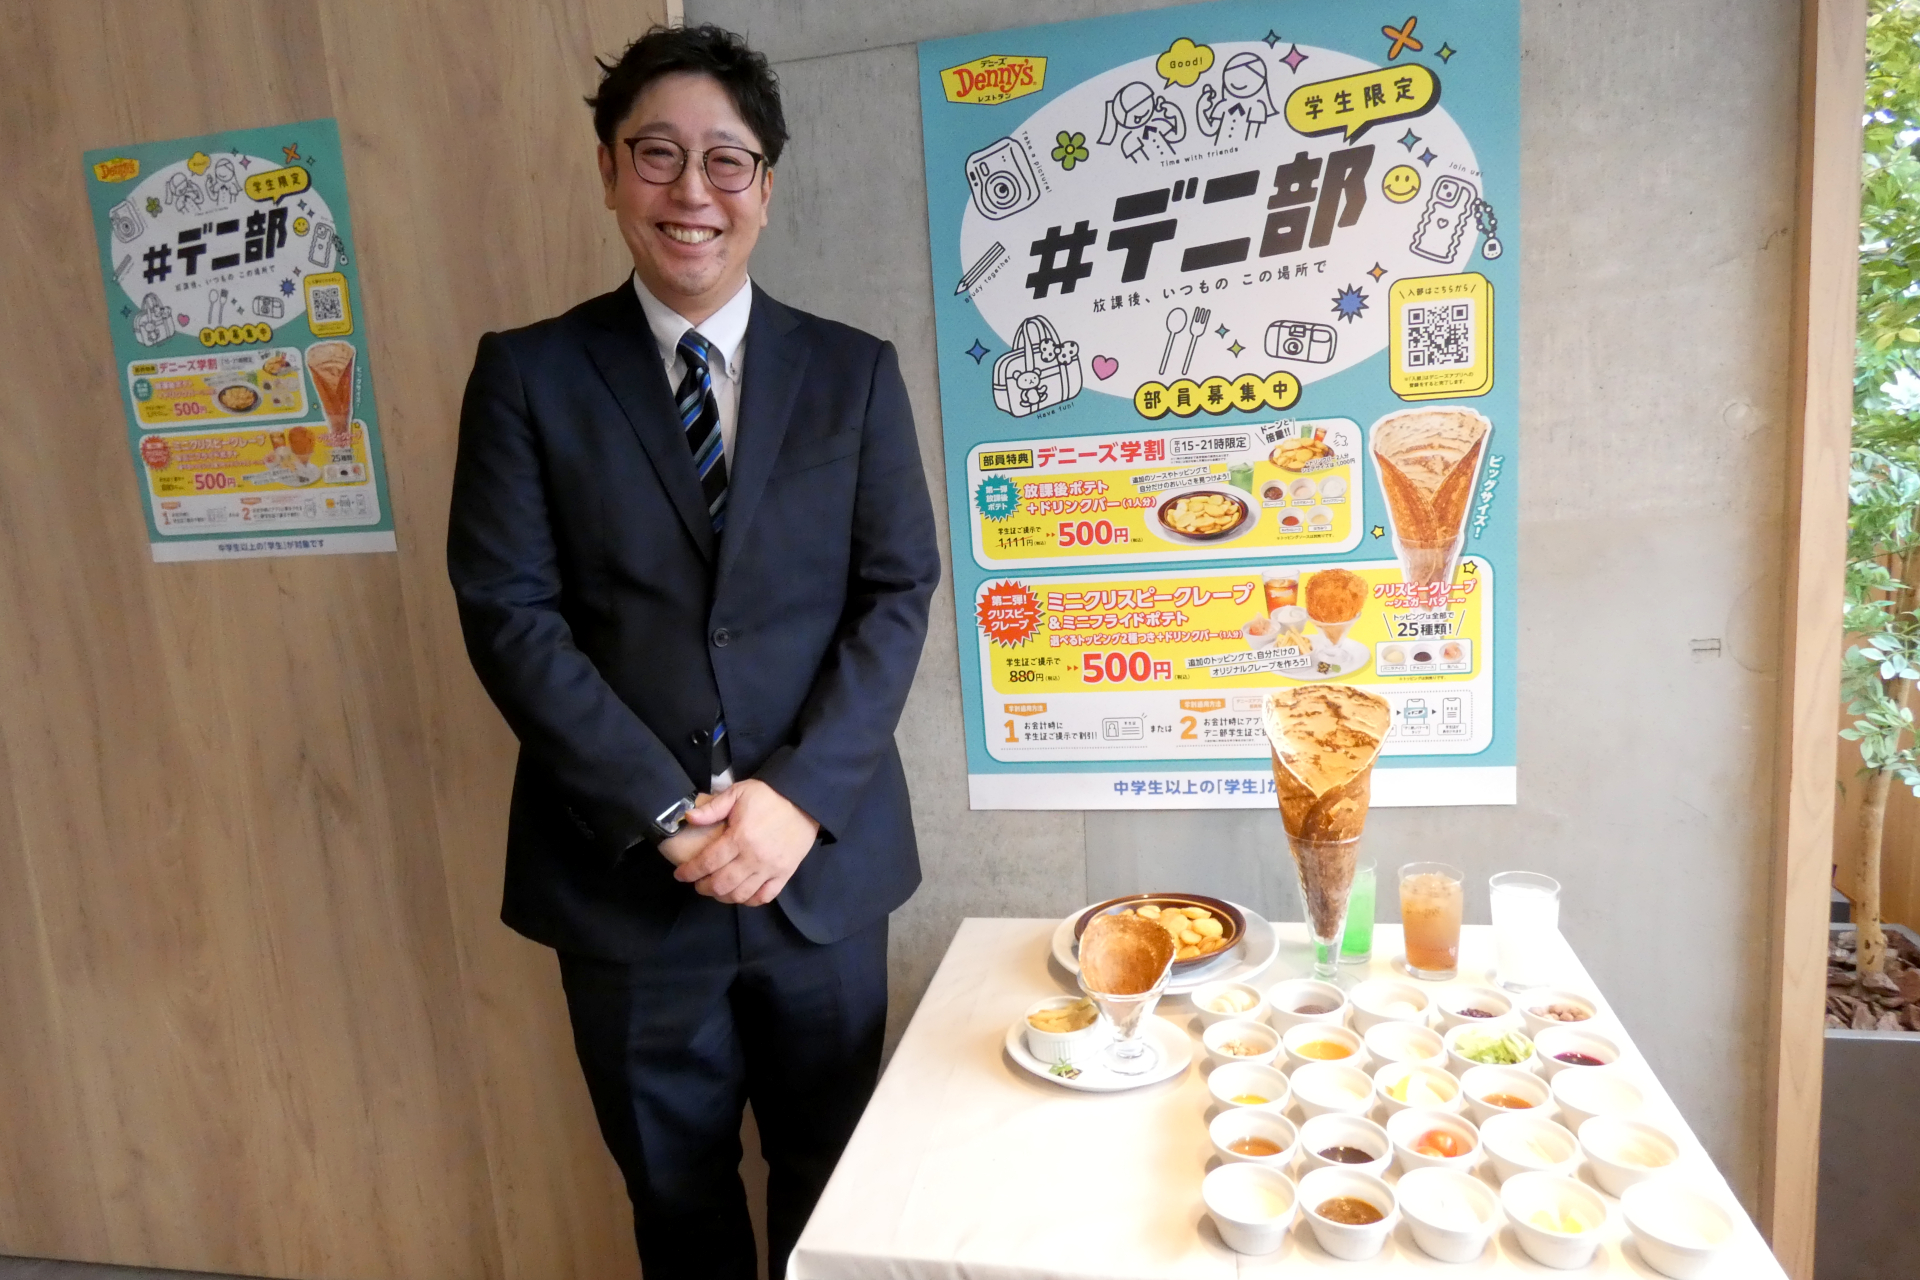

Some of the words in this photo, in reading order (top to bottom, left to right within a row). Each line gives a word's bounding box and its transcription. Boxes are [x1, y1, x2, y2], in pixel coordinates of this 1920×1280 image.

[980, 58, 1006, 68] デニーズ
[1169, 57, 1203, 69] Good!
[953, 59, 1034, 97] Denny's
[978, 92, 1011, 102] レストラン
[1304, 77, 1415, 119] 学生限定
[1022, 131, 1033, 150] Take
[1033, 161, 1052, 193] picture!
[1160, 159, 1181, 168] Time
[1184, 153, 1204, 165] with
[1207, 147, 1239, 160] friends
[1449, 162, 1467, 173] Join
[252, 172, 302, 194] 学生限定
[1025, 144, 1376, 300] #デニ部
[142, 207, 288, 284] #デニ部
[984, 255, 1013, 284] together
[1092, 278, 1229, 313] 放課後、いつもの
[1242, 260, 1327, 286] この場所で
[1407, 283, 1469, 298] 入部はこちらから
[160, 358, 218, 373] デニーズ学割
[1143, 380, 1288, 410] 部員募集中
[1036, 407, 1056, 420] Have
[1058, 402, 1076, 414] fun!
[1261, 419, 1292, 434] ドーンと
[1037, 438, 1165, 467] デニーズ学割
[1181, 436, 1247, 451] 15-21時限定
[982, 452, 1029, 466] 部員特典
[195, 472, 236, 490] 500円
[1132, 466, 1208, 484] 追加のソースやトッピングで
[1023, 480, 1109, 499] 放課後ポテト
[1474, 455, 1503, 539] ビッグサイズ!
[988, 503, 1008, 511] ポテト
[1059, 520, 1129, 547] 500円
[1047, 582, 1254, 612] ミニクリスピークレープ
[1374, 579, 1478, 598] クリスピークレープ
[991, 594, 1027, 606] 第二弾!
[988, 608, 1034, 620] クリスピー
[1048, 610, 1189, 631] &ミニフライドポテト
[1393, 612, 1455, 621] トッピングは全部で
[990, 619, 1029, 631] クレープ
[1397, 622, 1453, 637] 25種類!
[1006, 656, 1061, 667] 学生証ご提示で
[1187, 647, 1296, 667] 追加のトッピングで、自分だけの
[1083, 651, 1172, 683] 500円
[1212, 658, 1309, 677] オリジナルクレープを作ろう!
[1024, 721, 1063, 730] お会計時に
[1150, 724, 1172, 734] または
[1179, 715, 1198, 740] 2
[1203, 717, 1263, 726] お会計時にアプ
[1004, 719, 1019, 743] 1
